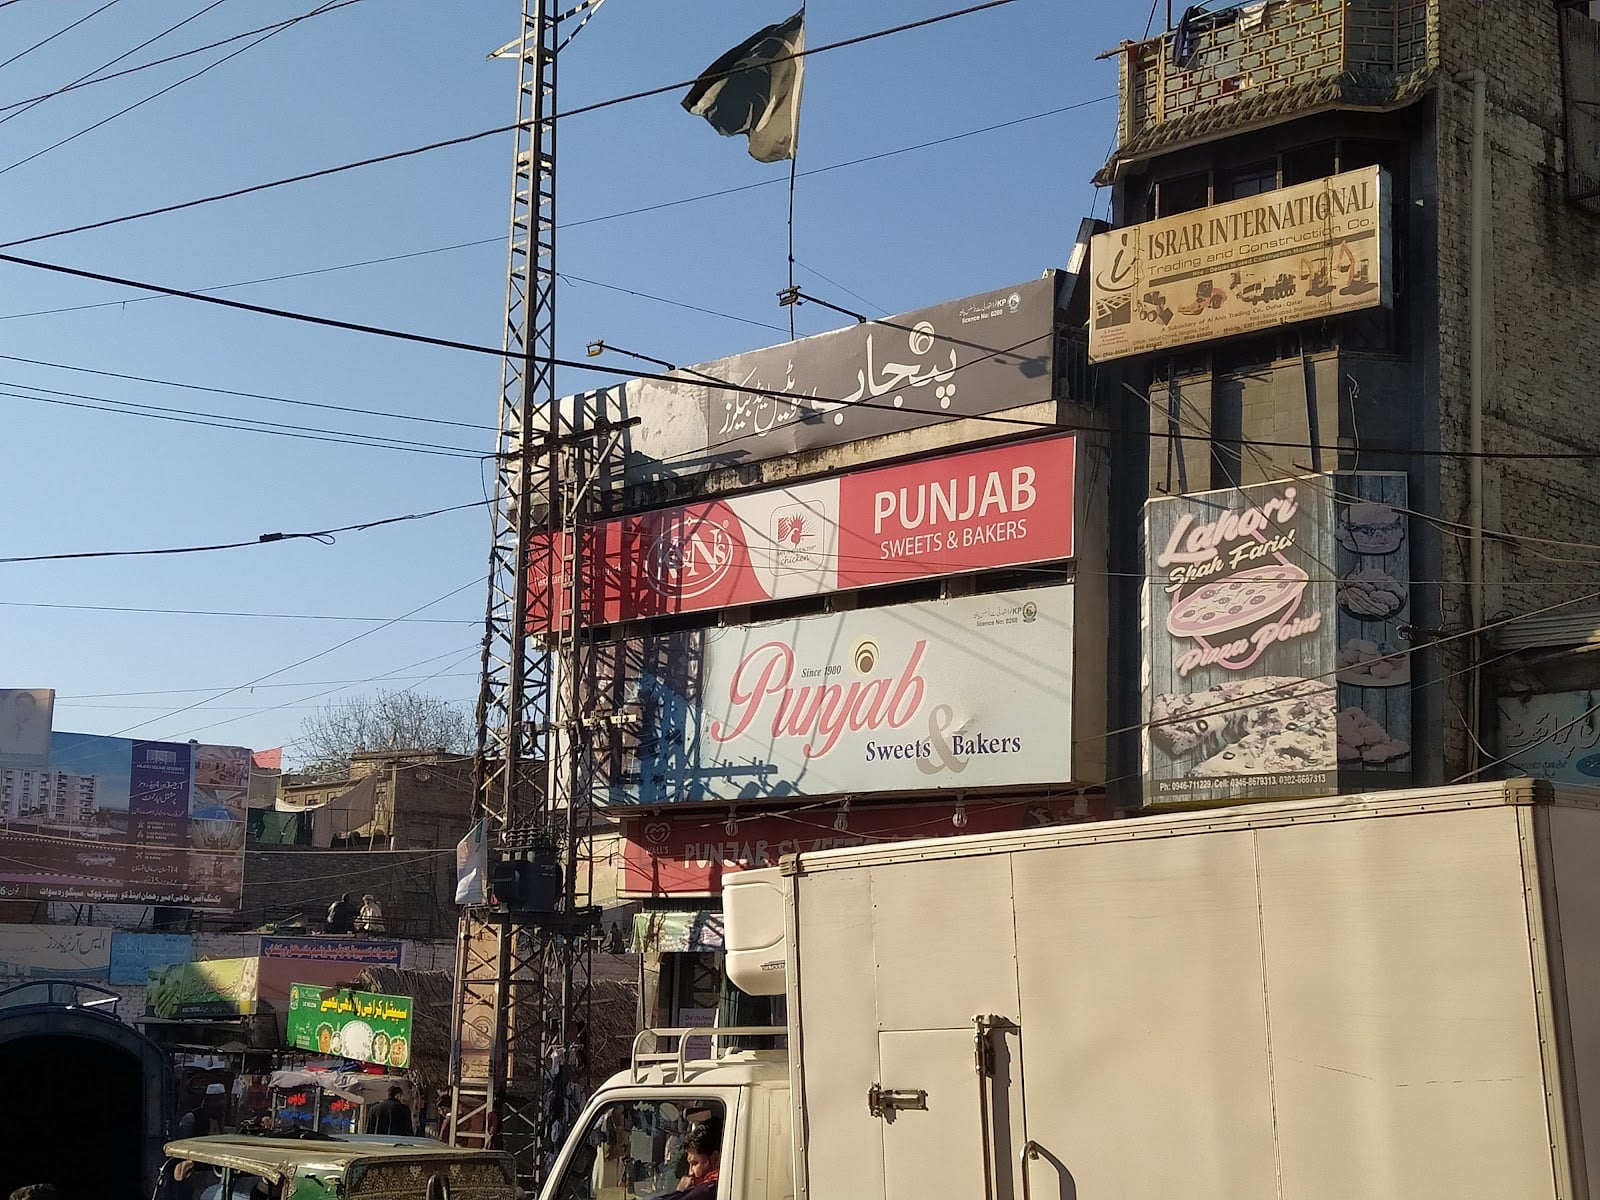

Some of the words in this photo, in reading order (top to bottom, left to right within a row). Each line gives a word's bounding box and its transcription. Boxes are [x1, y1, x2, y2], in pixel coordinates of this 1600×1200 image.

[1148, 222, 1204, 261] ISRAR
[1209, 181, 1374, 246] INTERNATIONAL
[1148, 256, 1202, 276] Trading
[1207, 248, 1233, 263] and
[1239, 223, 1340, 255] Construction
[1347, 218, 1374, 231] Co.
[810, 322, 957, 426] پنجاب
[873, 465, 1036, 535] PUNJAB
[1157, 486, 1297, 569] Lahori
[879, 536, 943, 560] SWEETS
[946, 531, 959, 551] &
[961, 519, 1027, 547] BAKERS
[1164, 558, 1225, 594] Shah
[1228, 529, 1297, 571] Farid
[801, 666, 822, 678] Since
[824, 664, 842, 677] 1980
[1175, 640, 1250, 678] Pizza
[1250, 612, 1323, 648] Point
[710, 639, 928, 760] Punjab
[865, 738, 931, 763] Sweets
[916, 703, 970, 775] &
[951, 733, 1021, 756] Bakers
[1159, 782, 1171, 791] Ph:
[684, 840, 770, 869] PUNJAB
